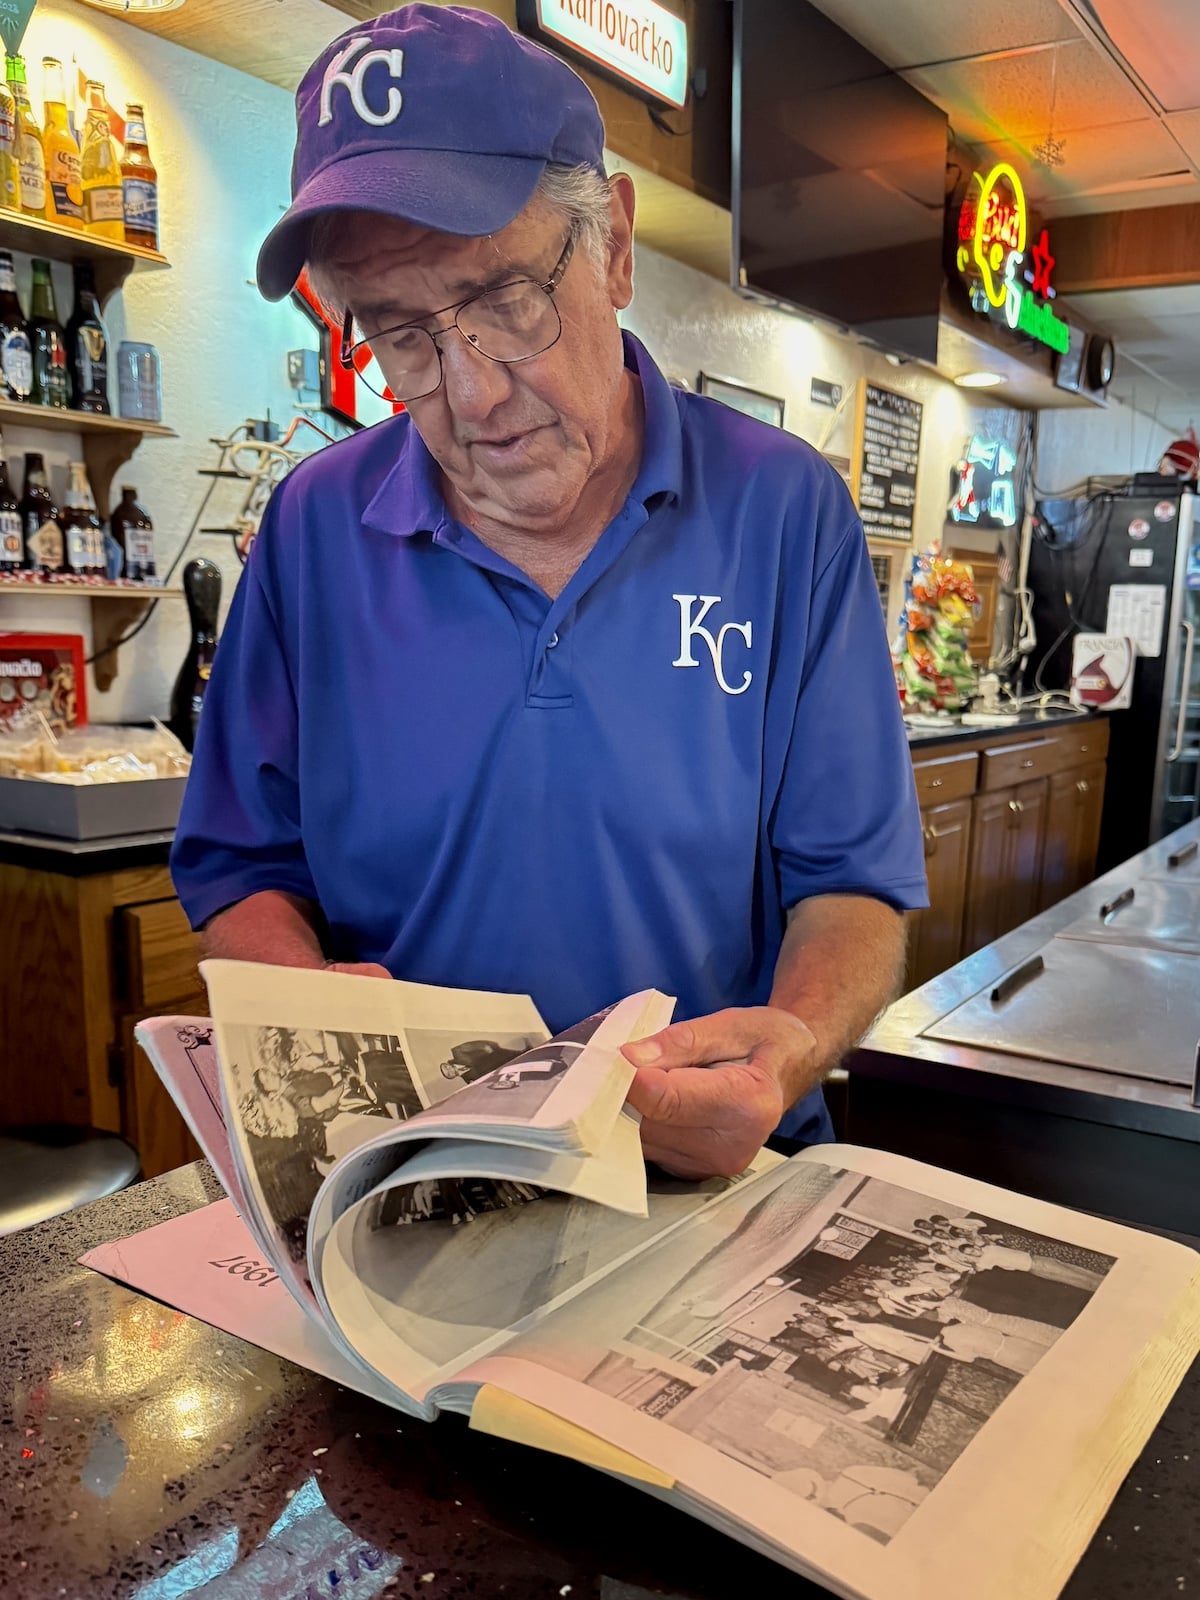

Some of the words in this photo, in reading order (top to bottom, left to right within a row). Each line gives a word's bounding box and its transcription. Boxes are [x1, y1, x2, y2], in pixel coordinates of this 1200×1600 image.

[318, 36, 403, 127] KC
[672, 593, 753, 695] KC
[207, 1255, 281, 1288] 1997
